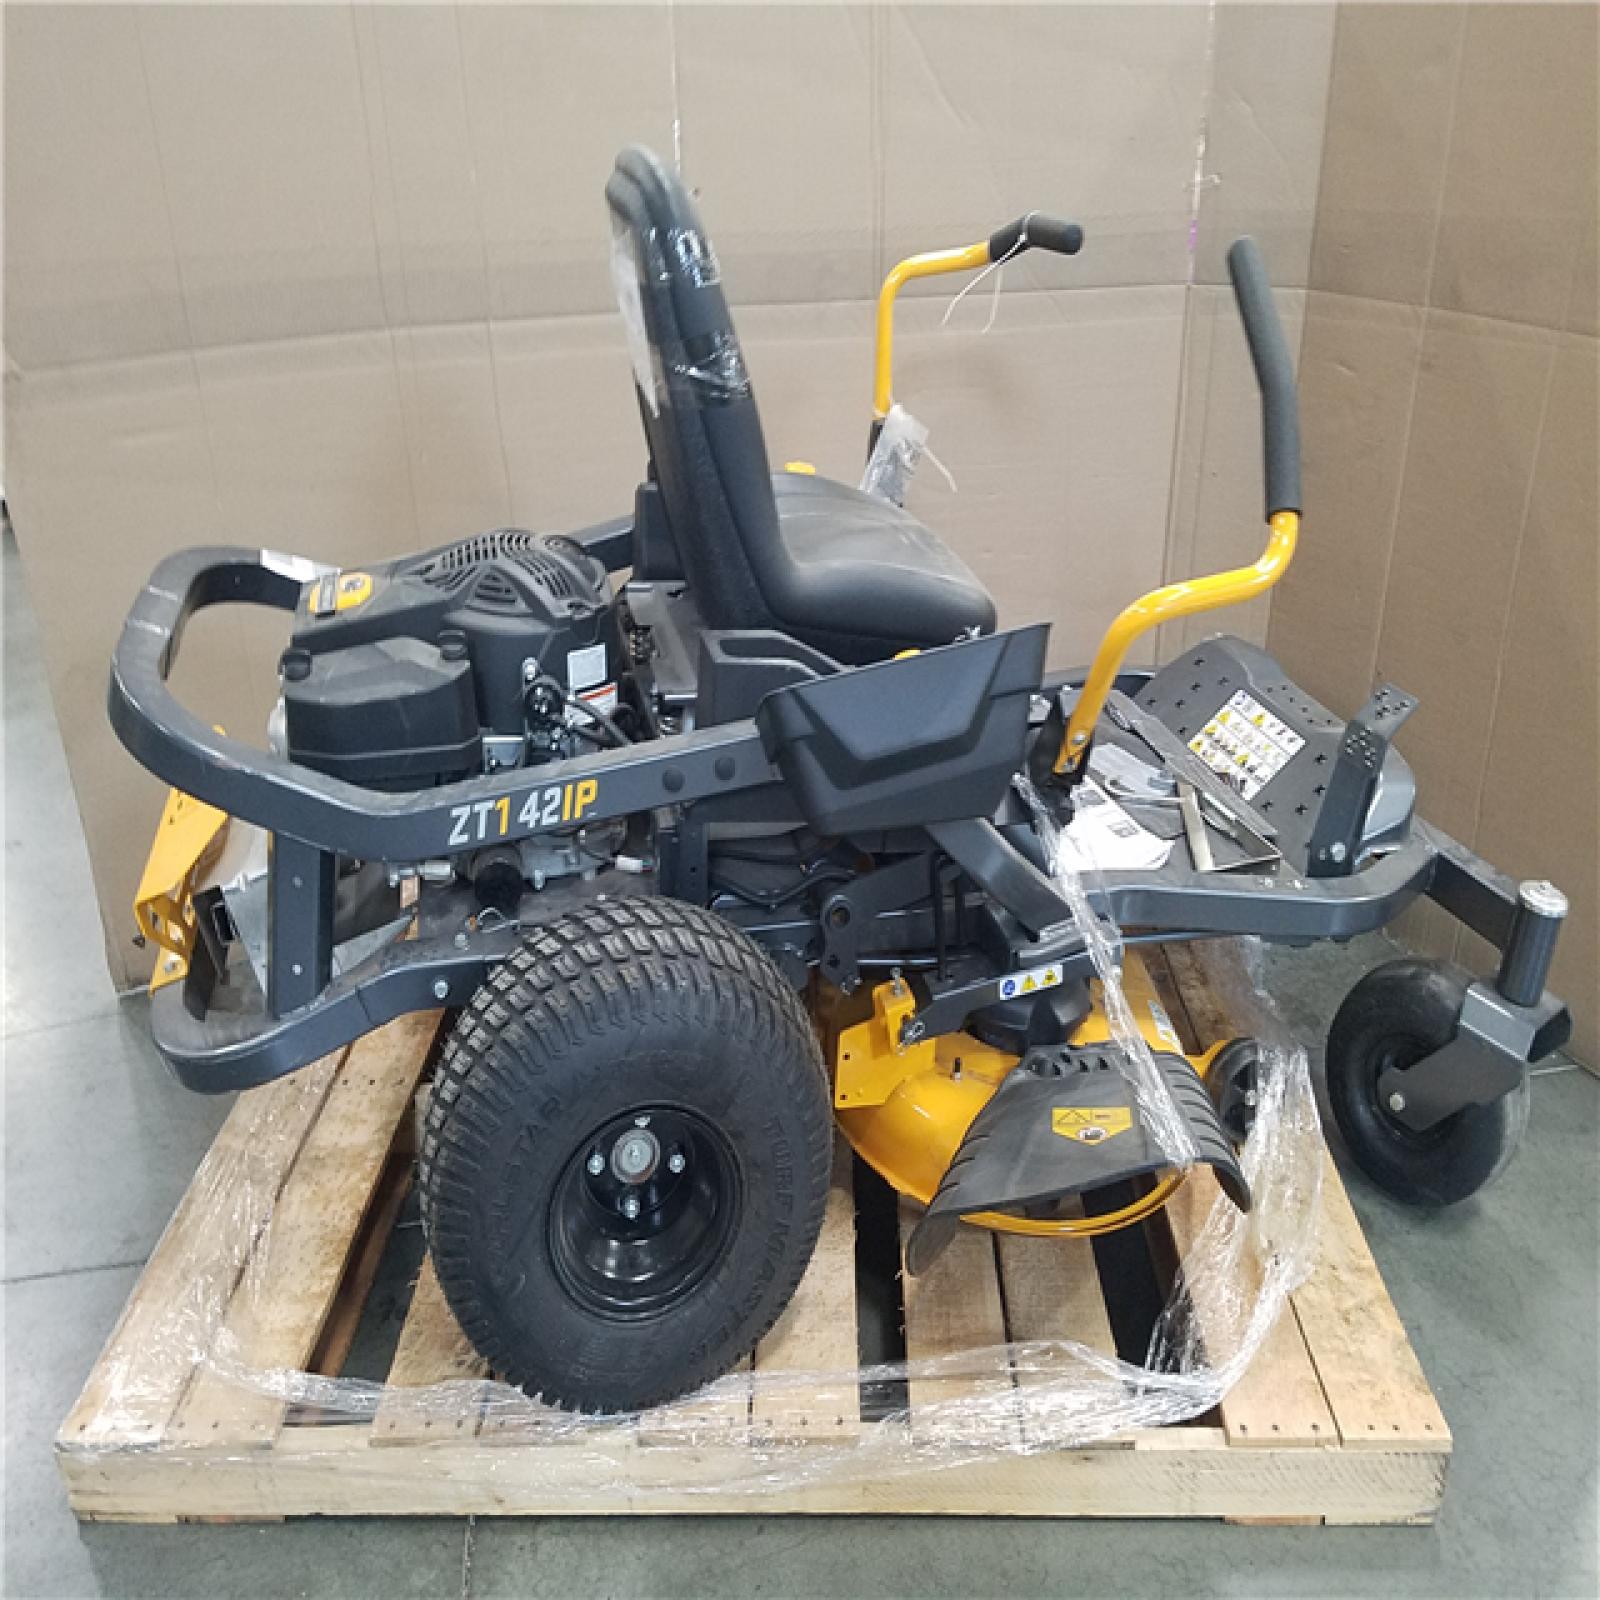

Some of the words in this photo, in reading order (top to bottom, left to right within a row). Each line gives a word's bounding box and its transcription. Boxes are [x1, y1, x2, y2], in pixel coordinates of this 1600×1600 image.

[447, 797, 511, 846] ZT1
[518, 779, 598, 829] 42IP
[763, 1117, 793, 1211] TURF
